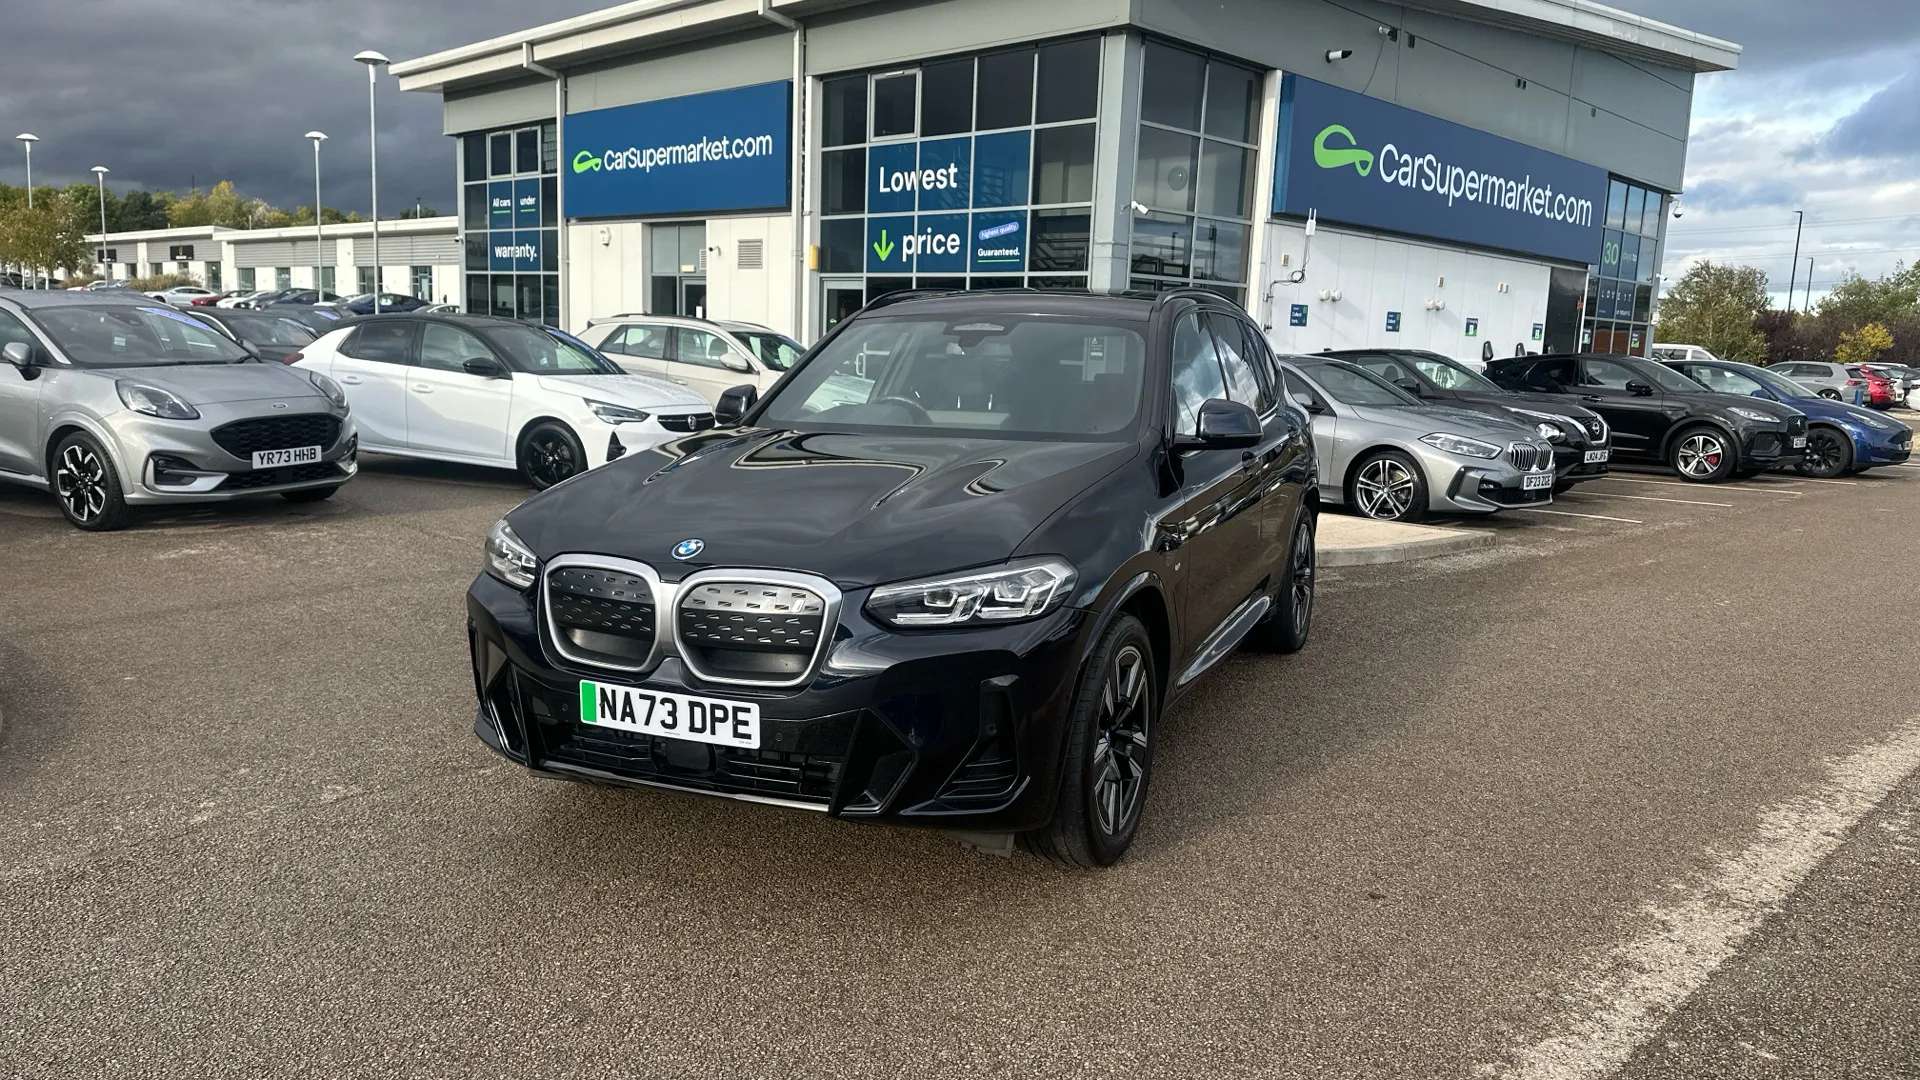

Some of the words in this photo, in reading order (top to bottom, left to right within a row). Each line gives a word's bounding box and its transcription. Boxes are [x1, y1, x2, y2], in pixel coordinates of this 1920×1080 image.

[604, 134, 773, 173] CarSupermarket.com
[879, 163, 959, 193] Lowest
[1379, 143, 1592, 227] CarSupermarket.com
[500, 199, 511, 207] cars
[520, 195, 536, 206] under
[494, 243, 537, 262] warranty.
[902, 227, 960, 262] price
[977, 247, 1020, 257] Guaranteed.
[1604, 242, 1619, 265] 30
[258, 450, 291, 465] YR73
[293, 447, 317, 462] HHB
[599, 687, 678, 730] NA73
[688, 700, 752, 740] DPE
